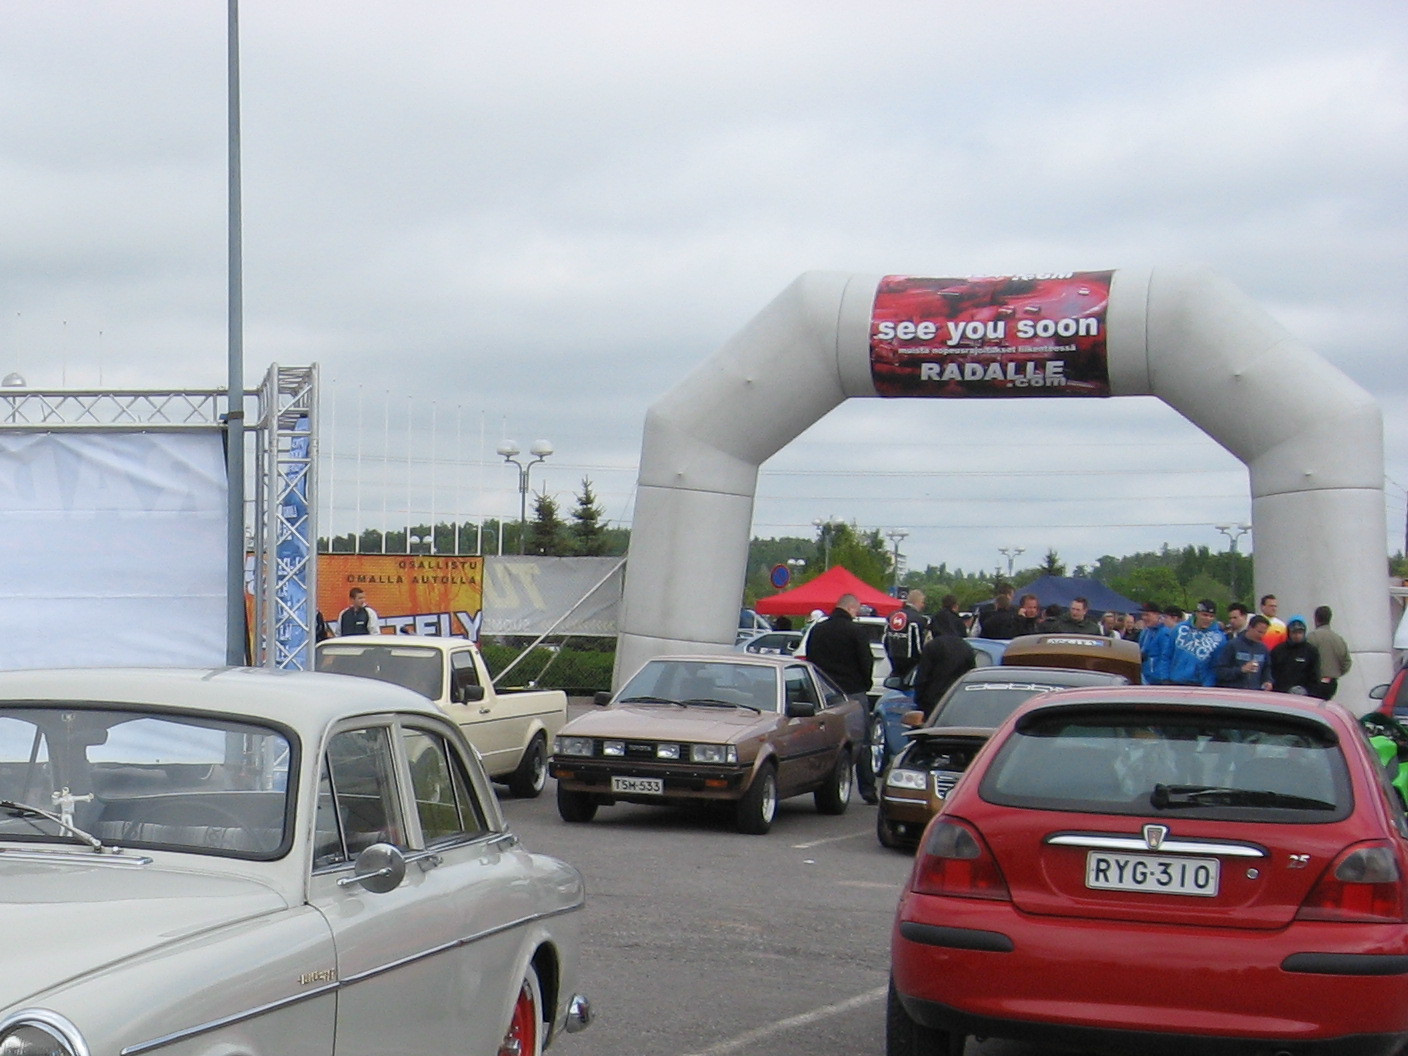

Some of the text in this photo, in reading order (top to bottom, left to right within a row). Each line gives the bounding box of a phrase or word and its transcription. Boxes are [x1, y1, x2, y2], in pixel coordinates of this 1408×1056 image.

[878, 316, 1099, 346] see you soon
[920, 360, 1066, 381] RADALLE
[1006, 377, 1067, 388] .com
[398, 560, 478, 571] OSALLISTU
[346, 574, 477, 585] OMALLA AUTOLLA
[1094, 857, 1211, 889] RYG-310
